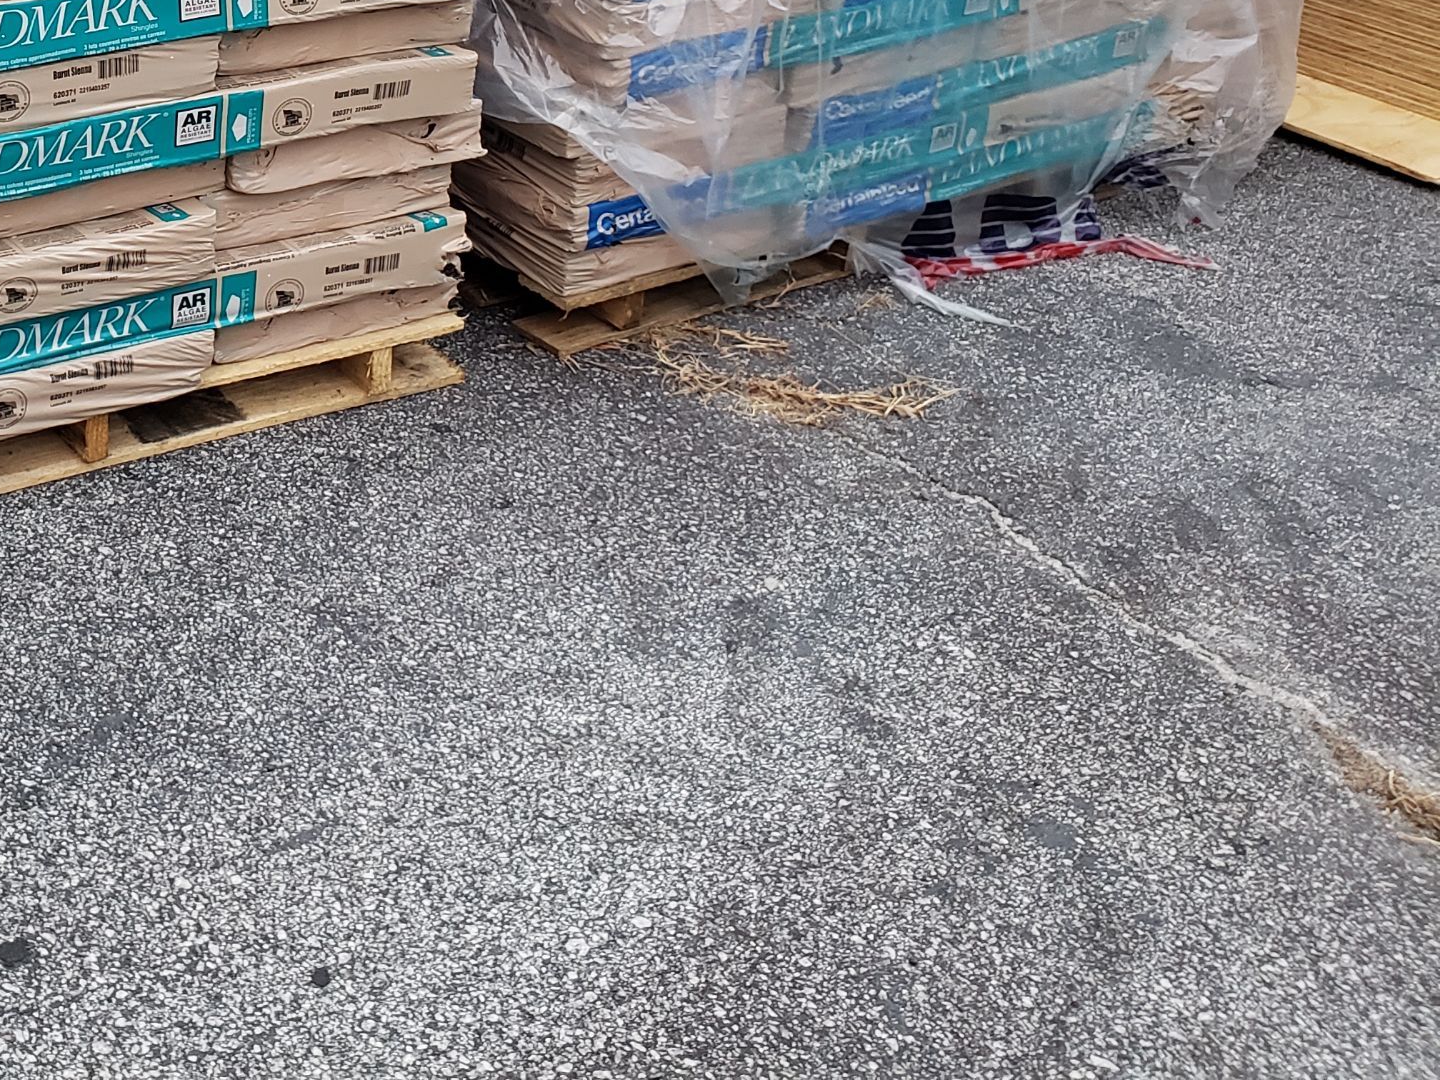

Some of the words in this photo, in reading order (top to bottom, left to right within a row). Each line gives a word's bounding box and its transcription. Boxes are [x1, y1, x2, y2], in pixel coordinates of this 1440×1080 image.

[184, 3, 217, 12] RESISTANT
[131, 21, 159, 33] Shingles
[182, 109, 212, 126] AR
[180, 130, 212, 139] RESISTANT
[181, 123, 211, 134] ALGAE
[178, 292, 206, 309] AR
[177, 306, 207, 318] ALGAE
